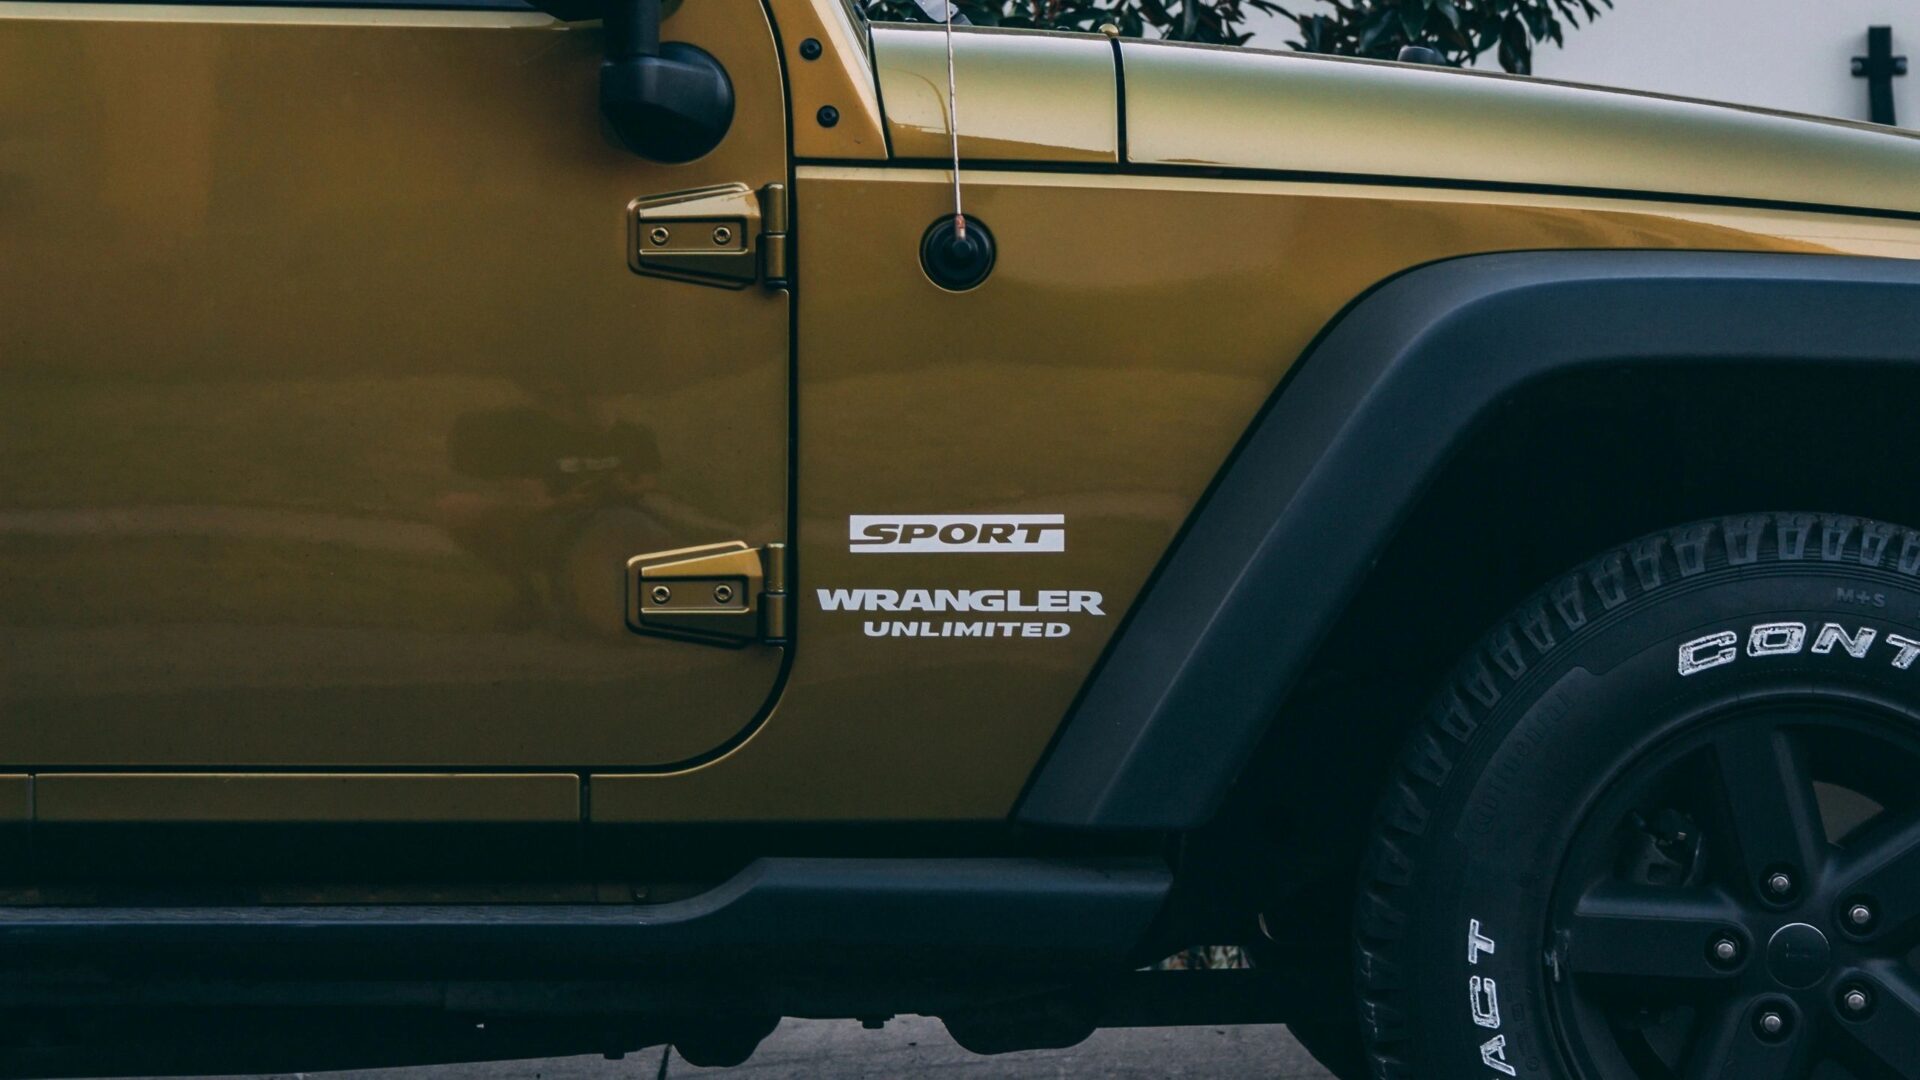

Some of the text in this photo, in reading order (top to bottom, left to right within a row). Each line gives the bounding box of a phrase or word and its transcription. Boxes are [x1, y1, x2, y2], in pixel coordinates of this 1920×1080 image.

[850, 523, 1064, 545] SPORT
[816, 588, 1107, 615] WRANGLER
[1836, 587, 1886, 608] M+S
[864, 621, 1071, 638] UNLIMITED
